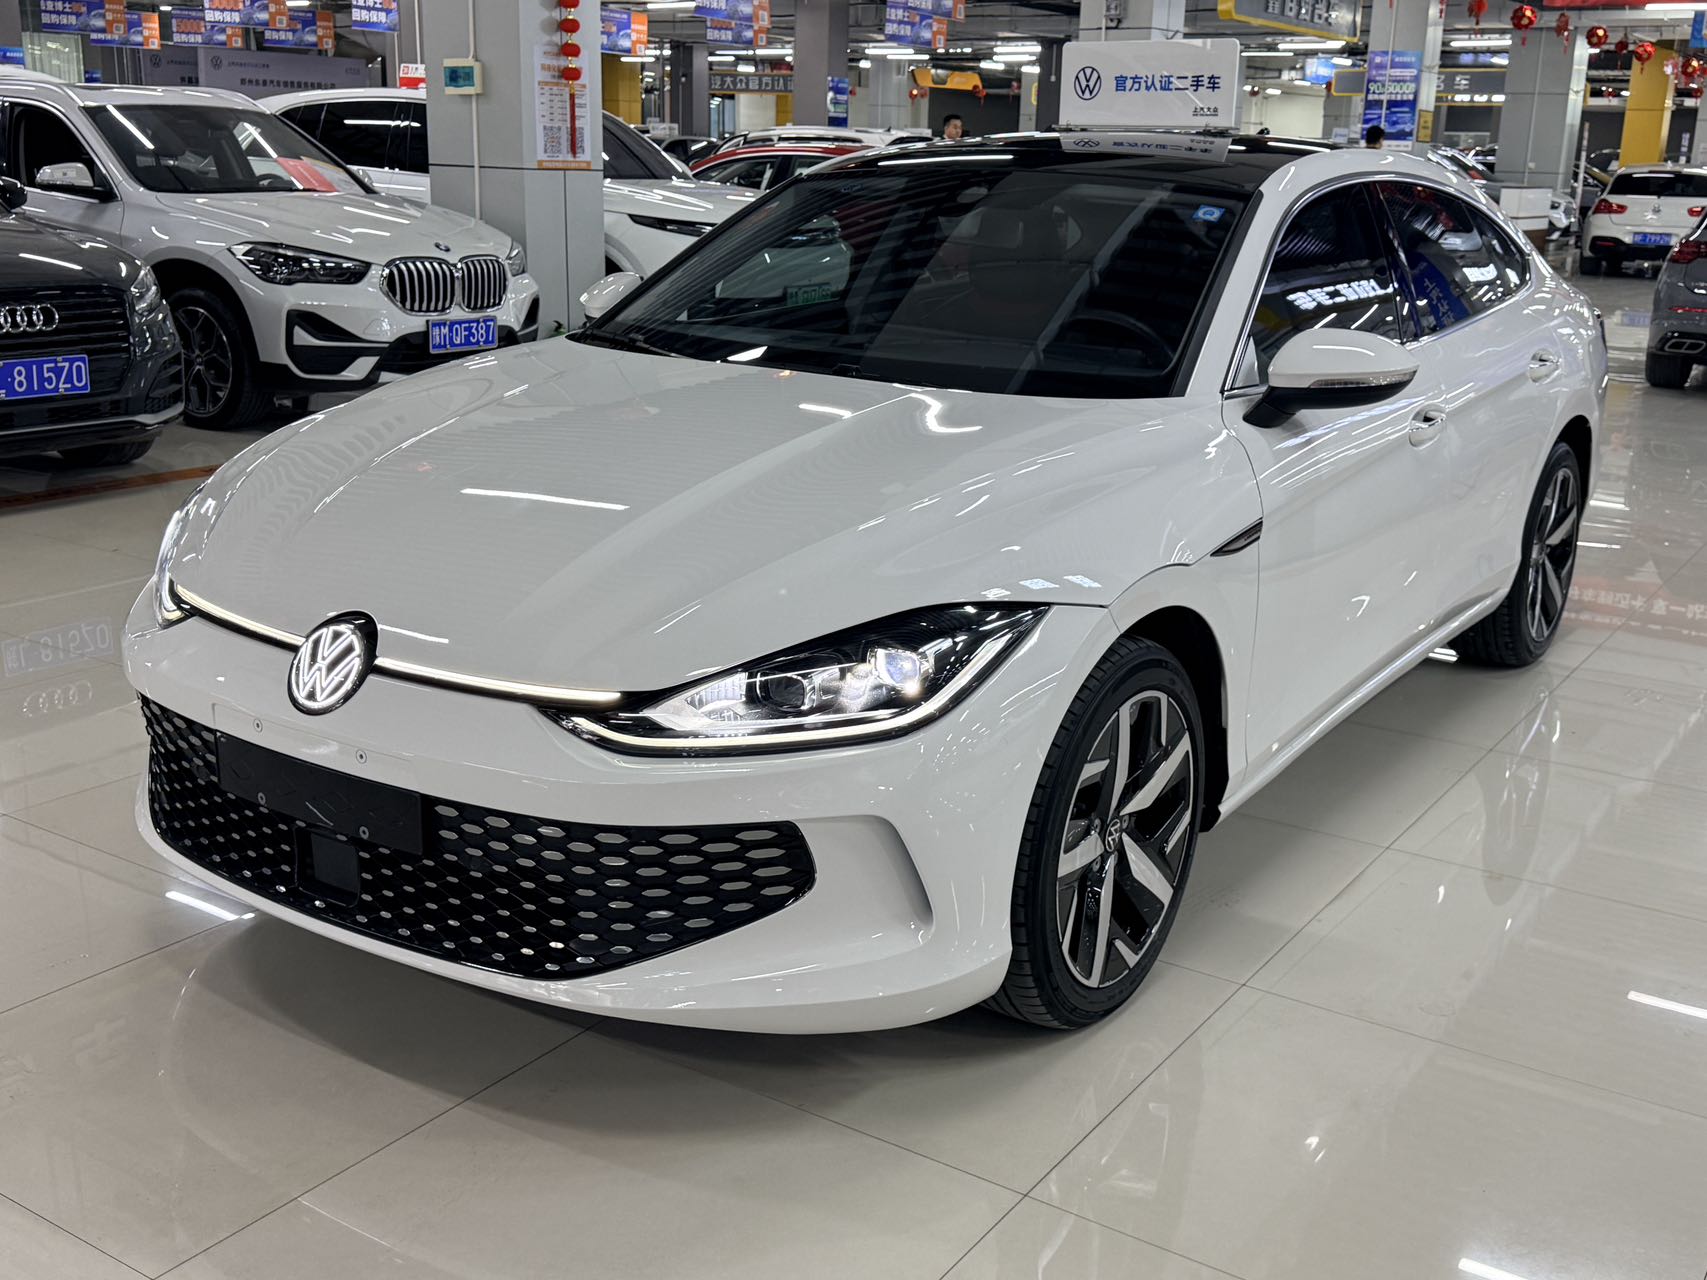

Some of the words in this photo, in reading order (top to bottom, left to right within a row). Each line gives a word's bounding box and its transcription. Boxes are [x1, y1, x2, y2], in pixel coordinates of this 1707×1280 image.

[1114, 74, 1221, 92] 官方认证二手车
[0, 361, 87, 393] ·815Z0
